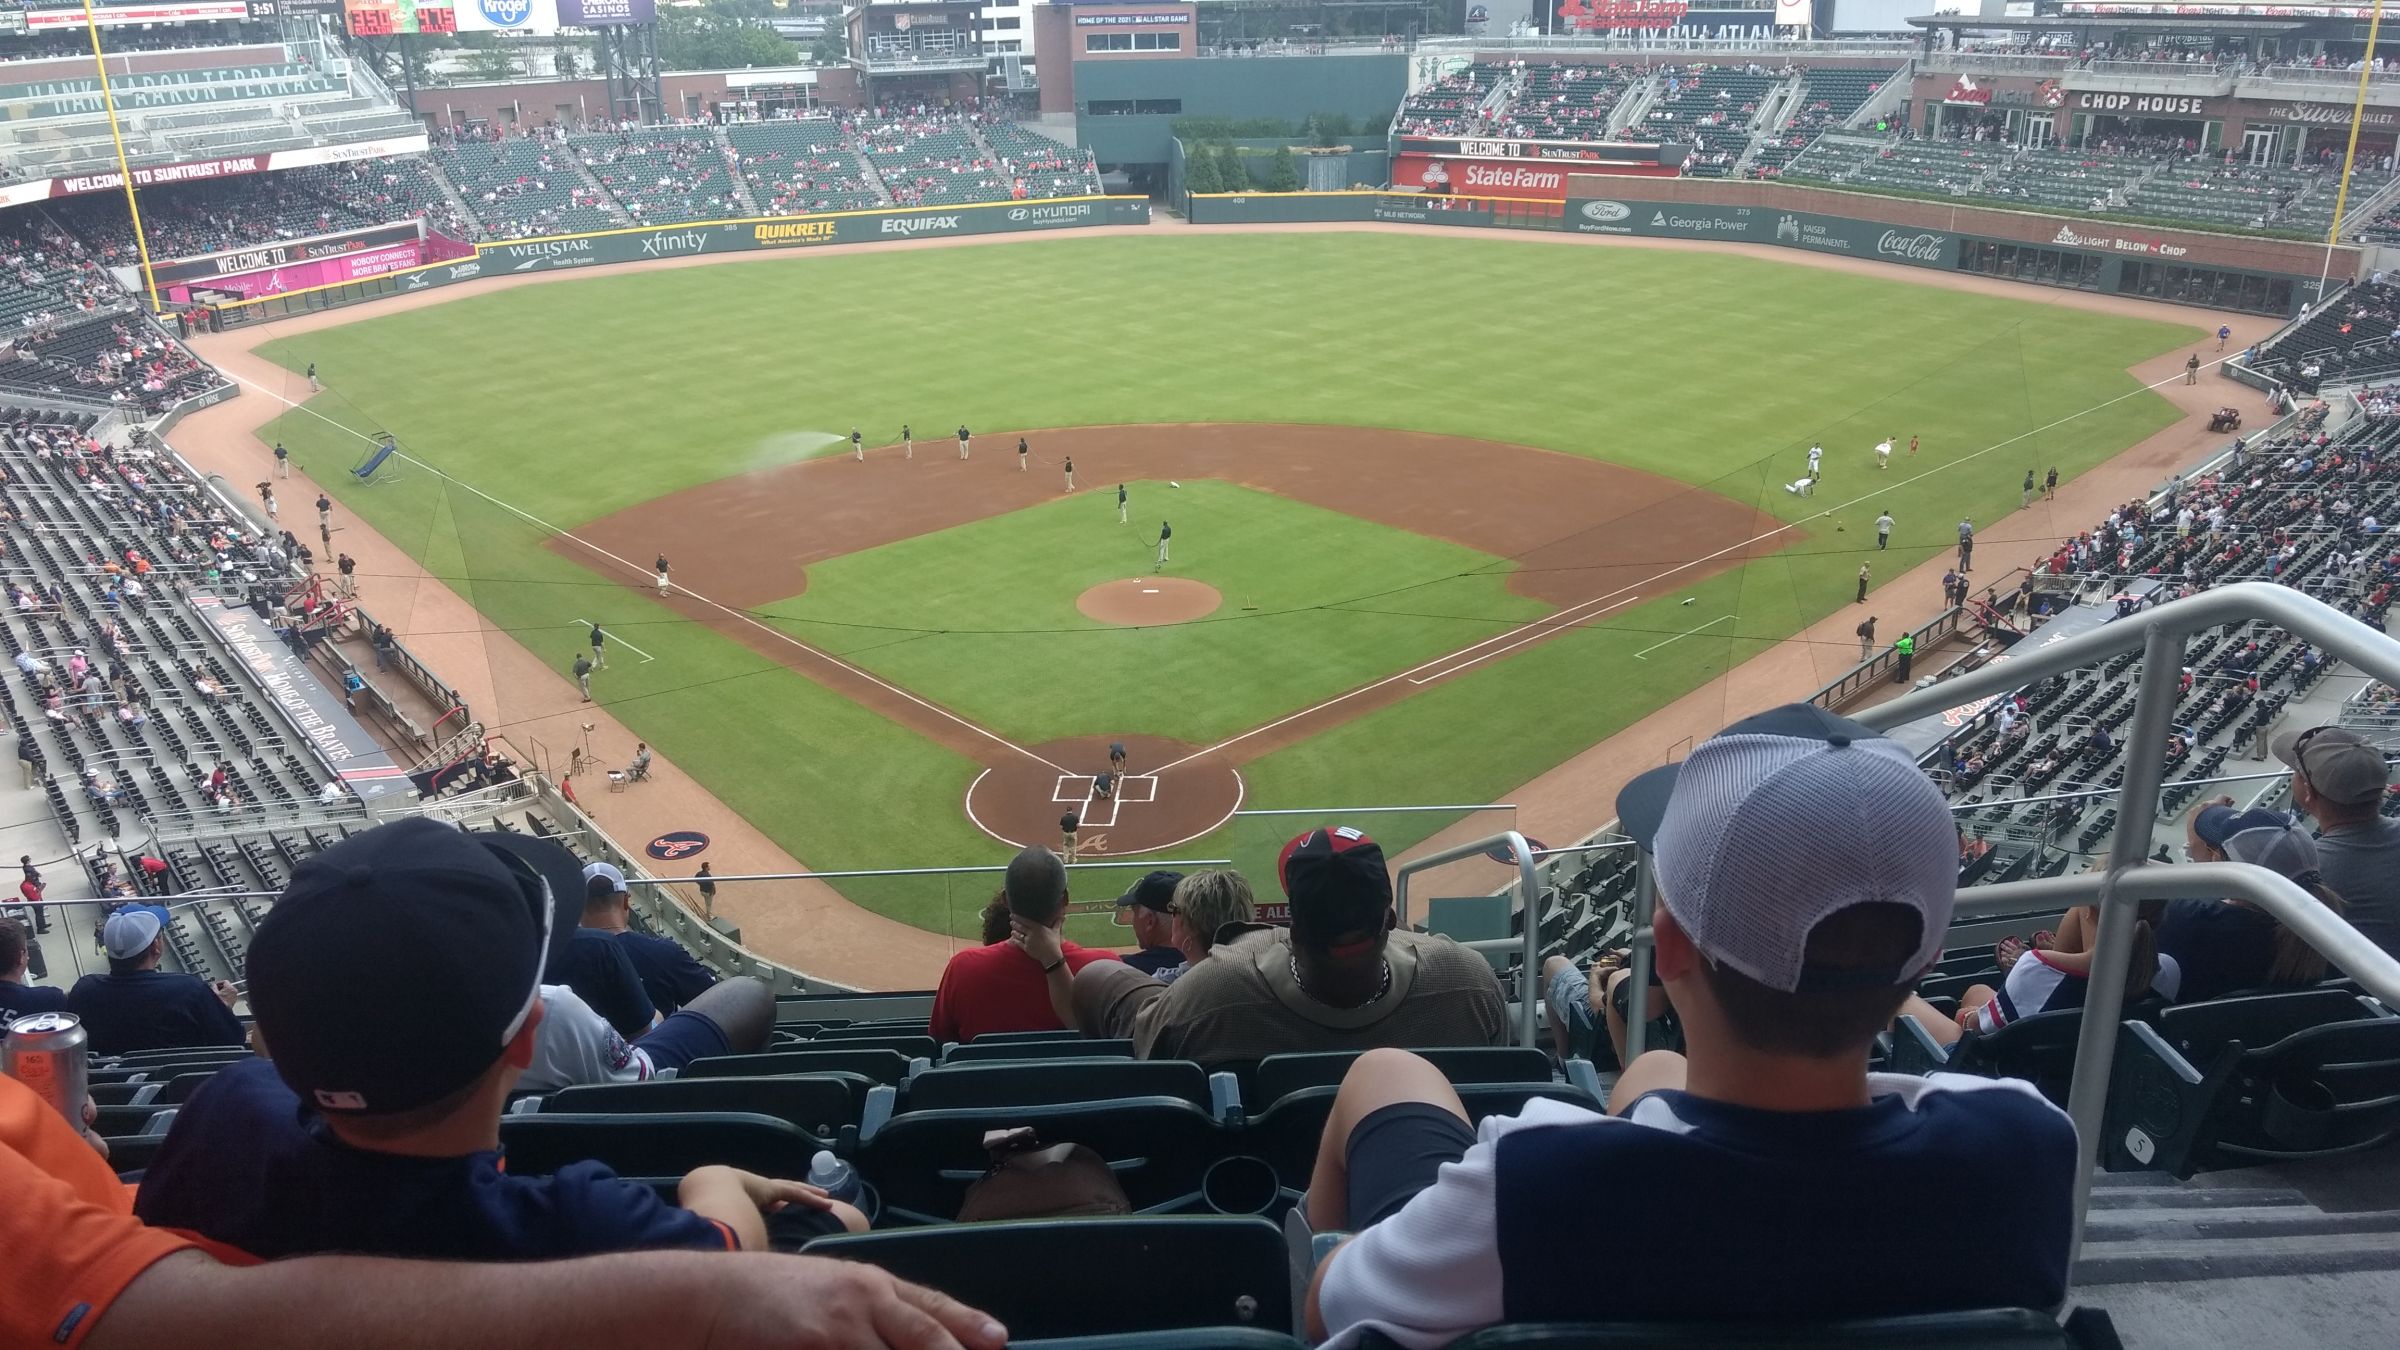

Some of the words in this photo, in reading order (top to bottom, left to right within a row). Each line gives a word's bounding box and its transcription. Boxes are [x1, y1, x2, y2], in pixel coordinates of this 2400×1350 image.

[252, 3, 274, 15] 3:51
[416, 8, 455, 25] 475
[485, 0, 527, 22] Kroger
[582, 5, 630, 14] CASINOS
[352, 9, 389, 26] 350
[1105, 16, 1115, 24] THE
[355, 26, 392, 35] MILLION
[420, 24, 457, 33] MILLION
[2080, 93, 2131, 109] CHOP
[2137, 96, 2203, 114] HOUSE
[2268, 107, 2288, 117] THE
[2361, 114, 2394, 124] ULLET
[1460, 141, 1506, 156] WELCOME
[1508, 142, 1521, 157] TO
[133, 170, 152, 184] TO
[153, 162, 221, 182] SUNTRUST
[222, 158, 257, 173] PARK
[1032, 204, 1091, 219] HYUNDAI
[1397, 211, 1426, 220] NETWORK
[1591, 203, 1621, 218] Ford
[1736, 208, 1751, 216] 375
[754, 221, 836, 240] QUIKRETE
[881, 215, 960, 236] EQUIFAX
[1669, 216, 1712, 231] Georgia
[1714, 217, 1748, 232] Power
[1803, 223, 1827, 235] KAISER
[508, 239, 591, 257] WELLSTAR
[641, 230, 708, 256] xfinity
[1802, 234, 1849, 249] PERMANENTE
[2083, 236, 2110, 248] LIGHT
[351, 256, 381, 268] NOBODY
[380, 248, 416, 263] CONNECTS
[479, 247, 495, 256] 375
[216, 250, 270, 273] WELCOME
[271, 248, 287, 263] TO
[352, 266, 373, 277] MORE
[399, 258, 416, 269] FANS
[553, 258, 573, 267] Health
[573, 257, 595, 266] System
[2302, 280, 2321, 290] 325
[310, 724, 355, 762] BRAVES
